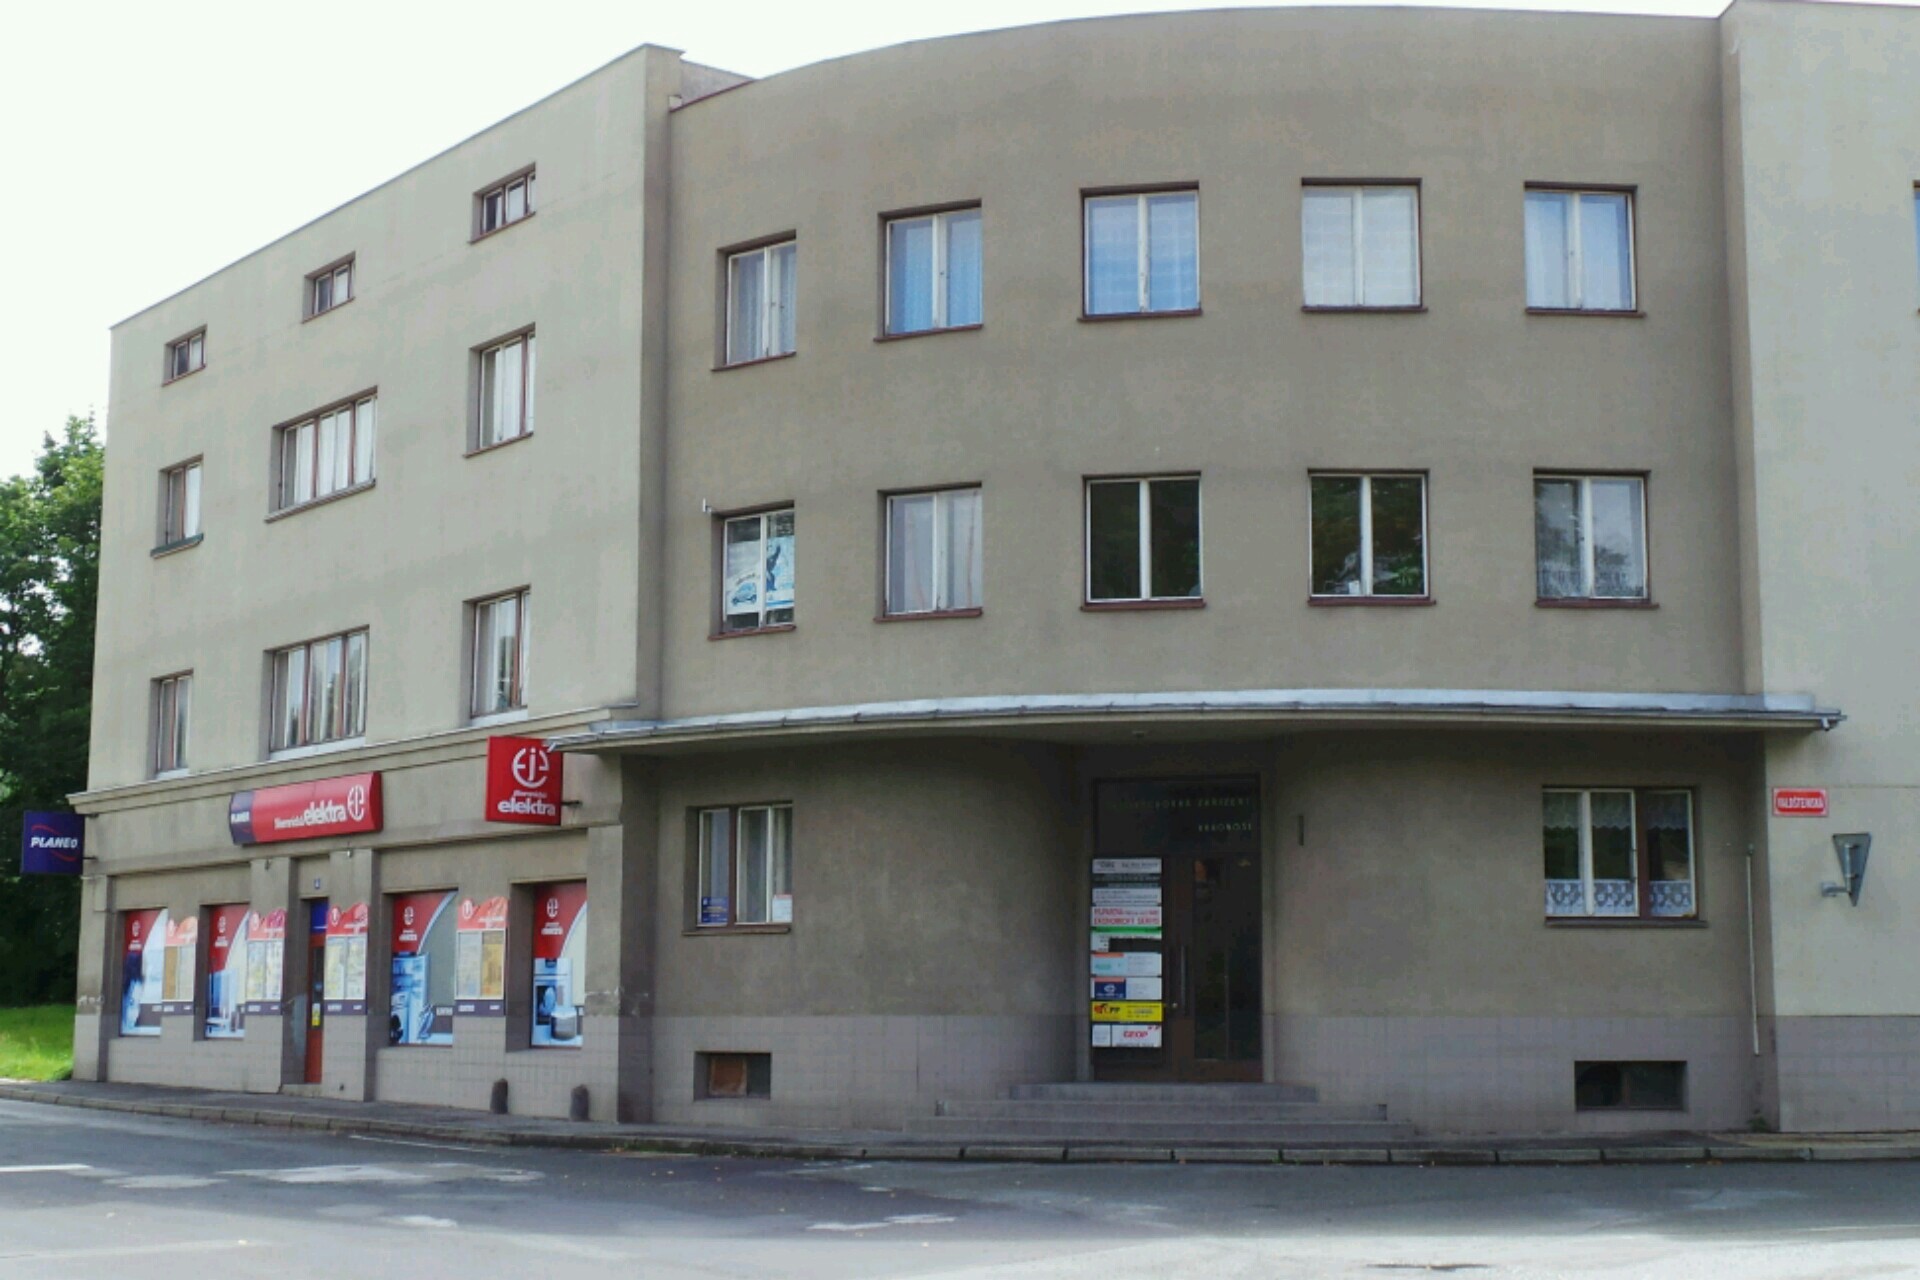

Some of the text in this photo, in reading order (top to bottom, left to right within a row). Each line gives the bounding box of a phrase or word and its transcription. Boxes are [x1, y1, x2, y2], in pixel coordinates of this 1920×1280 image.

[303, 800, 346, 826] elektra
[497, 797, 556, 816] elektra
[30, 837, 79, 848] PLANEO
